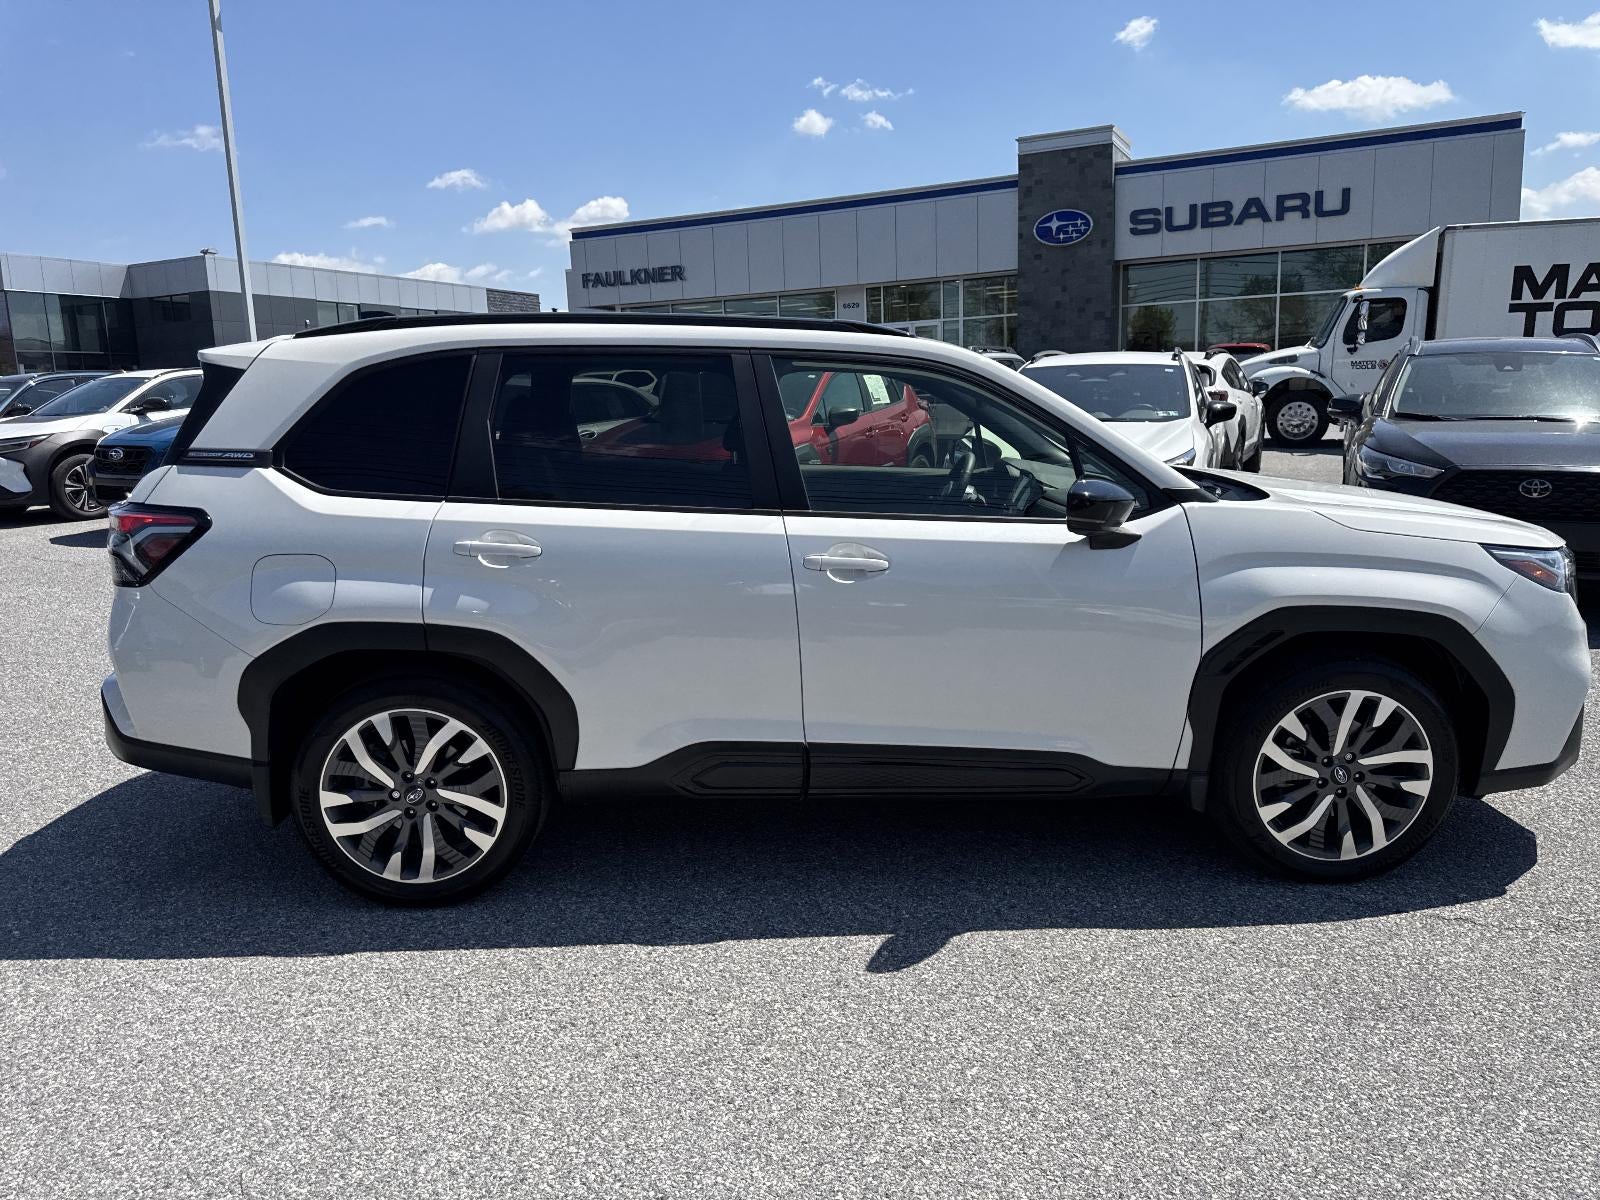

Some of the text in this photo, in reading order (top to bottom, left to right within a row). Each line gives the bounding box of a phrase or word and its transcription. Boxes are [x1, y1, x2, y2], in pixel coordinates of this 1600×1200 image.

[1129, 187, 1351, 236] SUBARU
[581, 264, 687, 289] FAULKNER
[1508, 301, 1600, 338] TO
